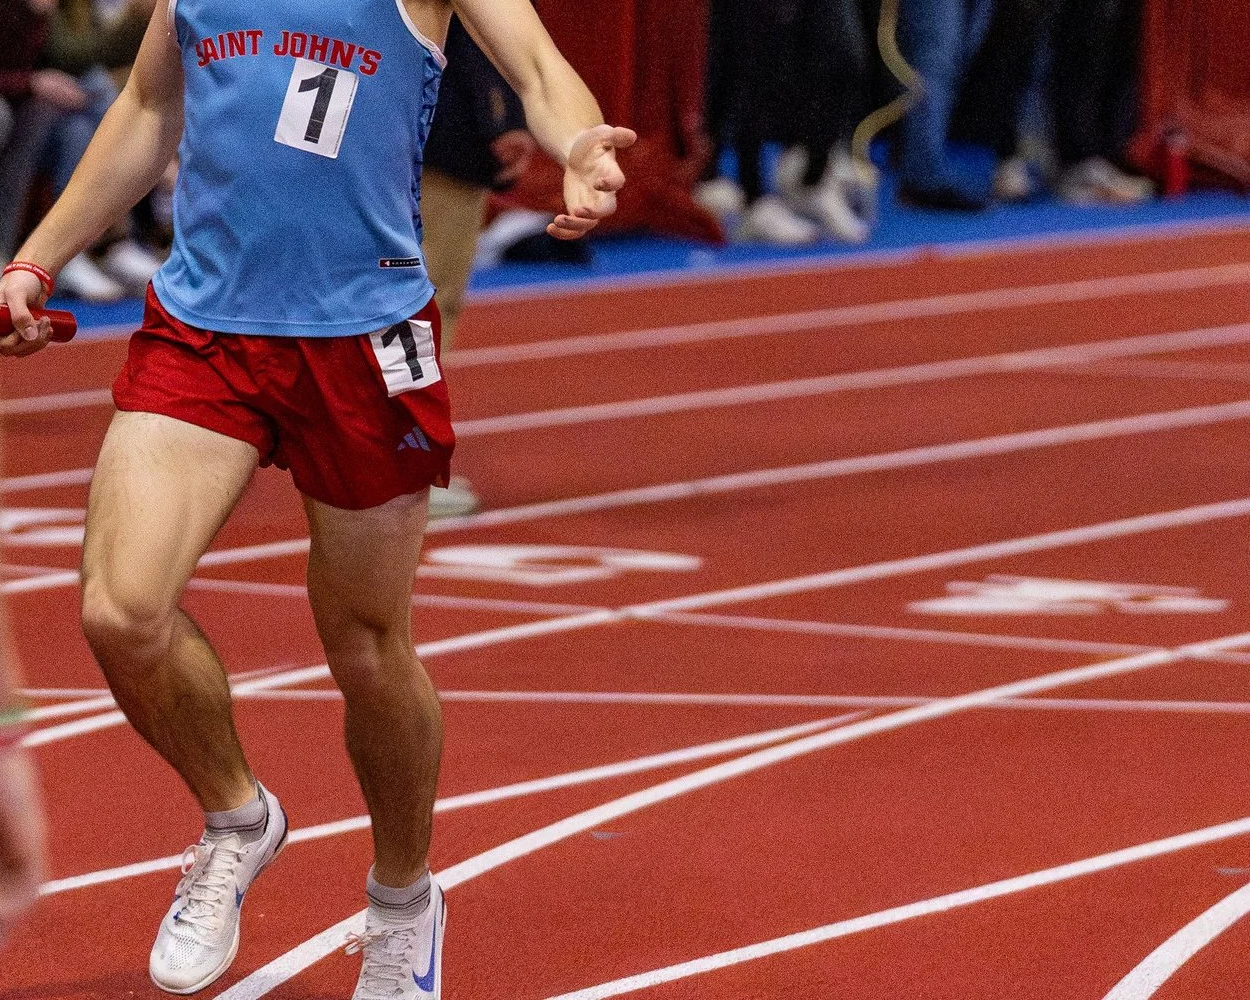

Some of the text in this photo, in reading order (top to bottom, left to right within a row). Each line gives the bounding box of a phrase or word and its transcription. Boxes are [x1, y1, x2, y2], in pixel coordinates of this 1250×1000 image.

[273, 30, 383, 77] JOHN'S
[297, 67, 339, 144] 1
[380, 320, 425, 382] 1
